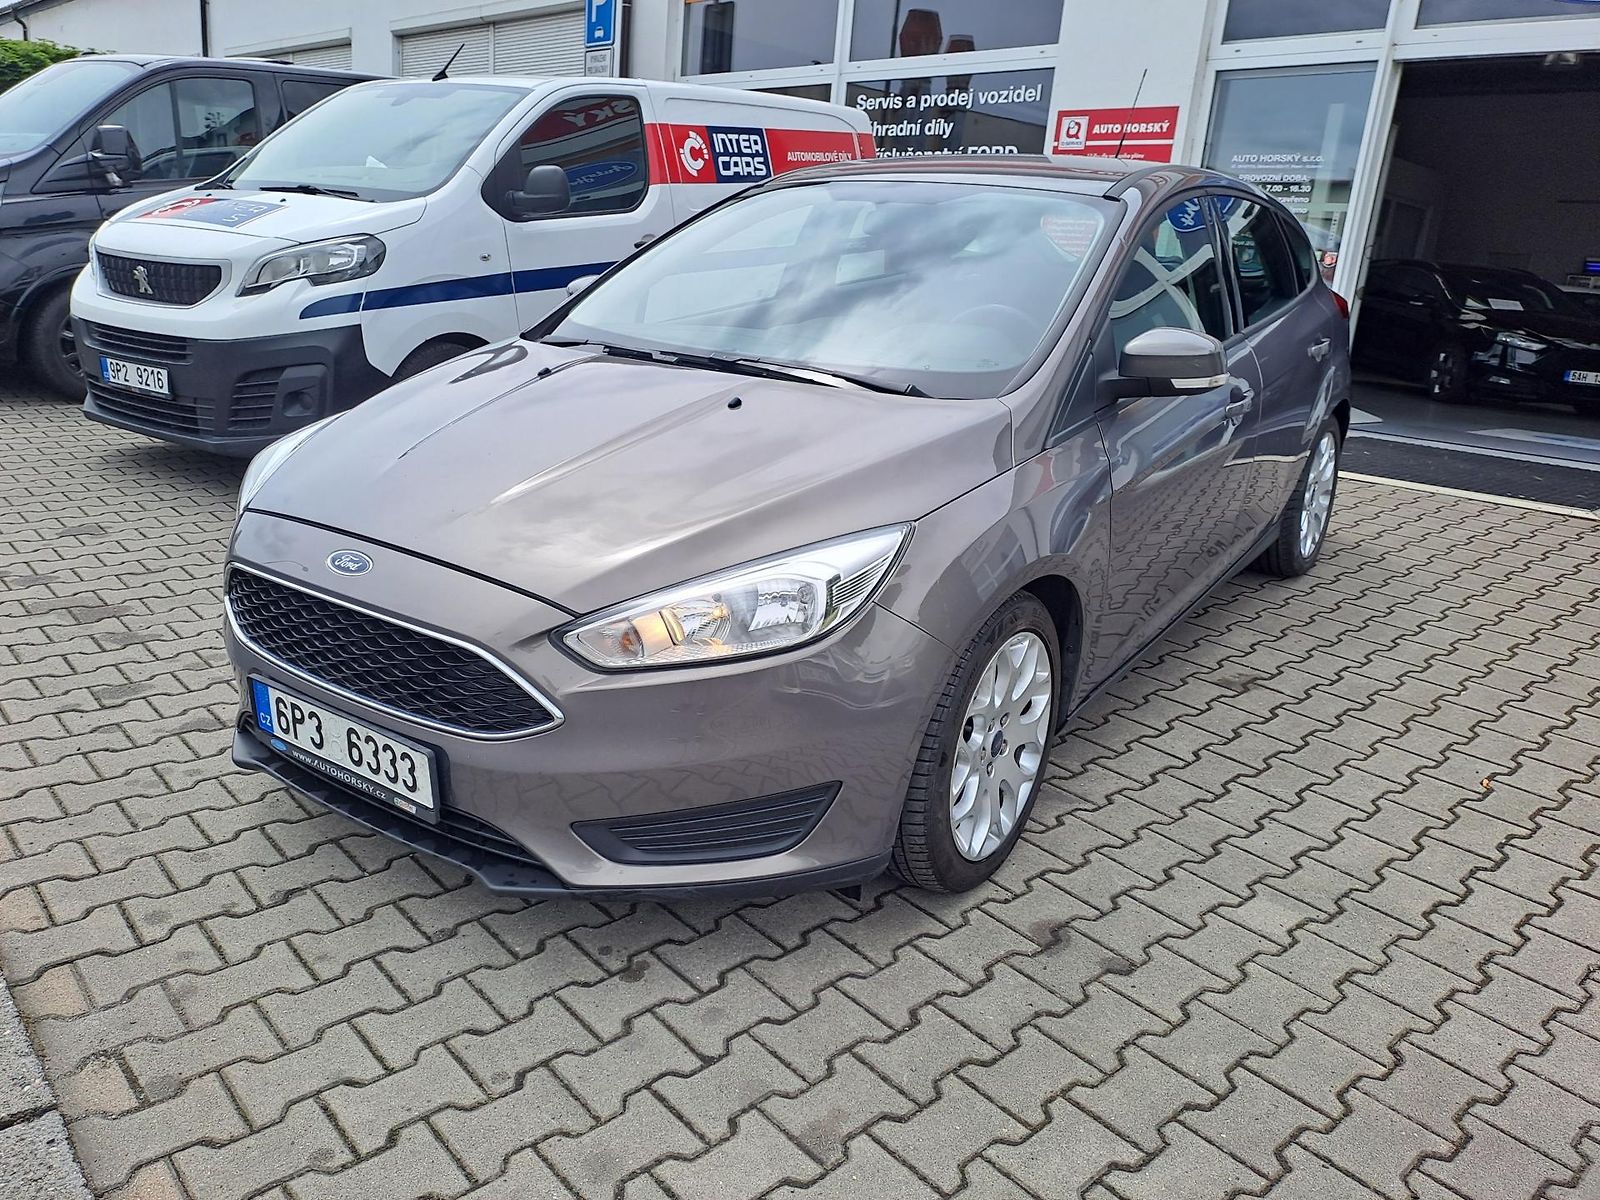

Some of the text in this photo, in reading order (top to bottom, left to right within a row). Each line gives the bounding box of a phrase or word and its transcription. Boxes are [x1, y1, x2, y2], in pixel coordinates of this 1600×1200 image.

[856, 84, 1043, 111] Servis a prodej vozidel
[872, 118, 954, 139] hradní díly
[1092, 119, 1170, 134] AUTO HORSKÝ
[712, 133, 763, 154] INTER
[718, 156, 767, 176] CARS
[787, 150, 839, 162] AUTOMOBILOVÉ
[1231, 154, 1257, 162] AUTO
[1260, 152, 1301, 162] HORSKÝ
[1266, 184, 1283, 192] 7.00
[109, 361, 130, 382] 9P2
[136, 366, 164, 389] 9216
[334, 554, 363, 571] Ford
[259, 696, 418, 793] CZ 6P3 6333
[291, 750, 387, 800] www.AUTOHORSKY.cz
